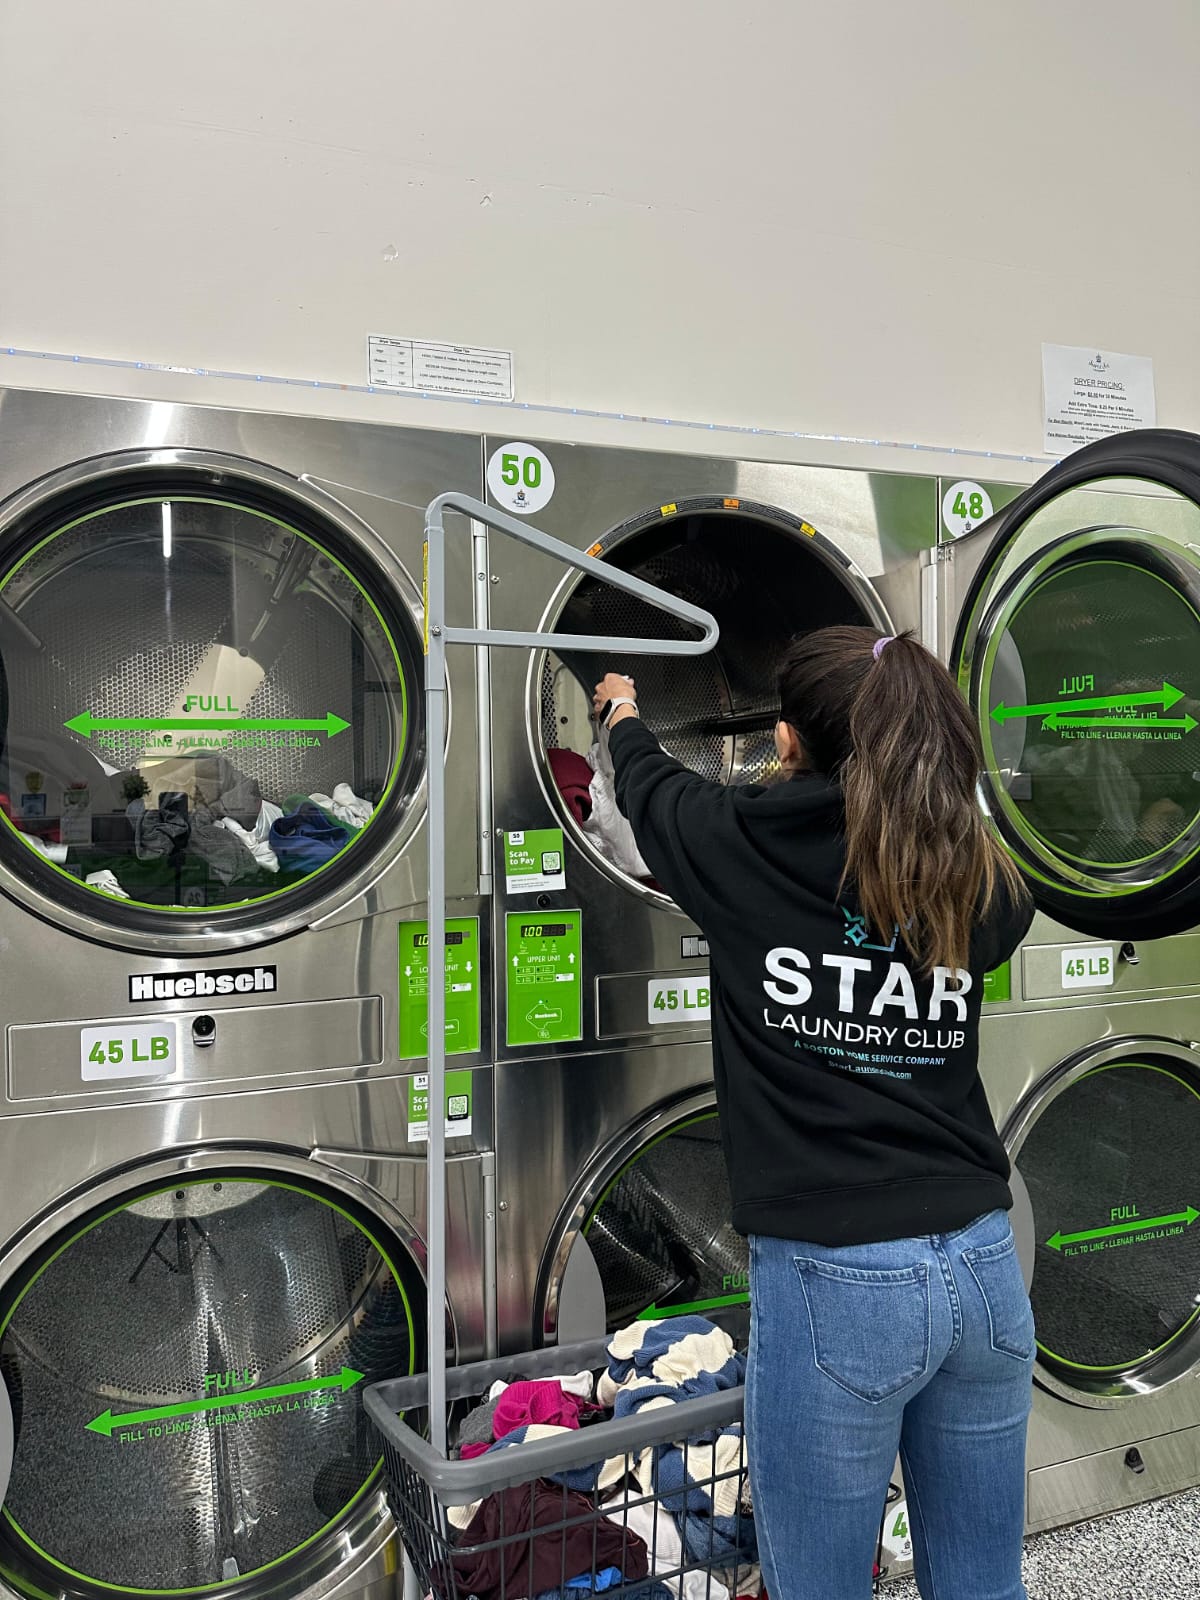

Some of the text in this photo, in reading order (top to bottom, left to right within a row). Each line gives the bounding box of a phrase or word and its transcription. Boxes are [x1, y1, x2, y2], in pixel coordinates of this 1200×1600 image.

[1073, 377, 1096, 388] DRYER
[501, 453, 541, 489] 50
[952, 491, 984, 519] 48
[186, 695, 239, 712] FULL
[145, 738, 173, 748] LINE
[289, 737, 321, 747] LINEA
[1061, 731, 1182, 740] FILL TO LINE LLENAR HASTA LA LINEA
[509, 850, 529, 858] Scan
[520, 857, 535, 866] Pay
[445, 963, 459, 972] UNIT
[527, 954, 561, 963] UPPER UNIT
[1065, 957, 1110, 977] 45 LB
[131, 967, 275, 1000] Huebsch
[762, 946, 973, 1022] STAR
[653, 988, 710, 1011] 45 LB
[763, 1008, 965, 1049] LAUNDRY CLUB
[88, 1036, 170, 1064] 45 LB
[794, 1039, 946, 1065] A BOSTON HOME SERVICE COMPANY
[413, 1096, 428, 1104] Sca
[1110, 1204, 1140, 1221] FULL
[1064, 1226, 1185, 1257] FILL TO LINE LLENAR HASTA LA LINEA
[722, 1271, 750, 1291] FUL
[204, 1368, 256, 1392] FULL
[120, 1430, 145, 1444] FILL
[148, 1427, 161, 1438] TO
[165, 1421, 192, 1435] LINE
[249, 1403, 283, 1418] HASTA
[287, 1400, 300, 1412] LA
